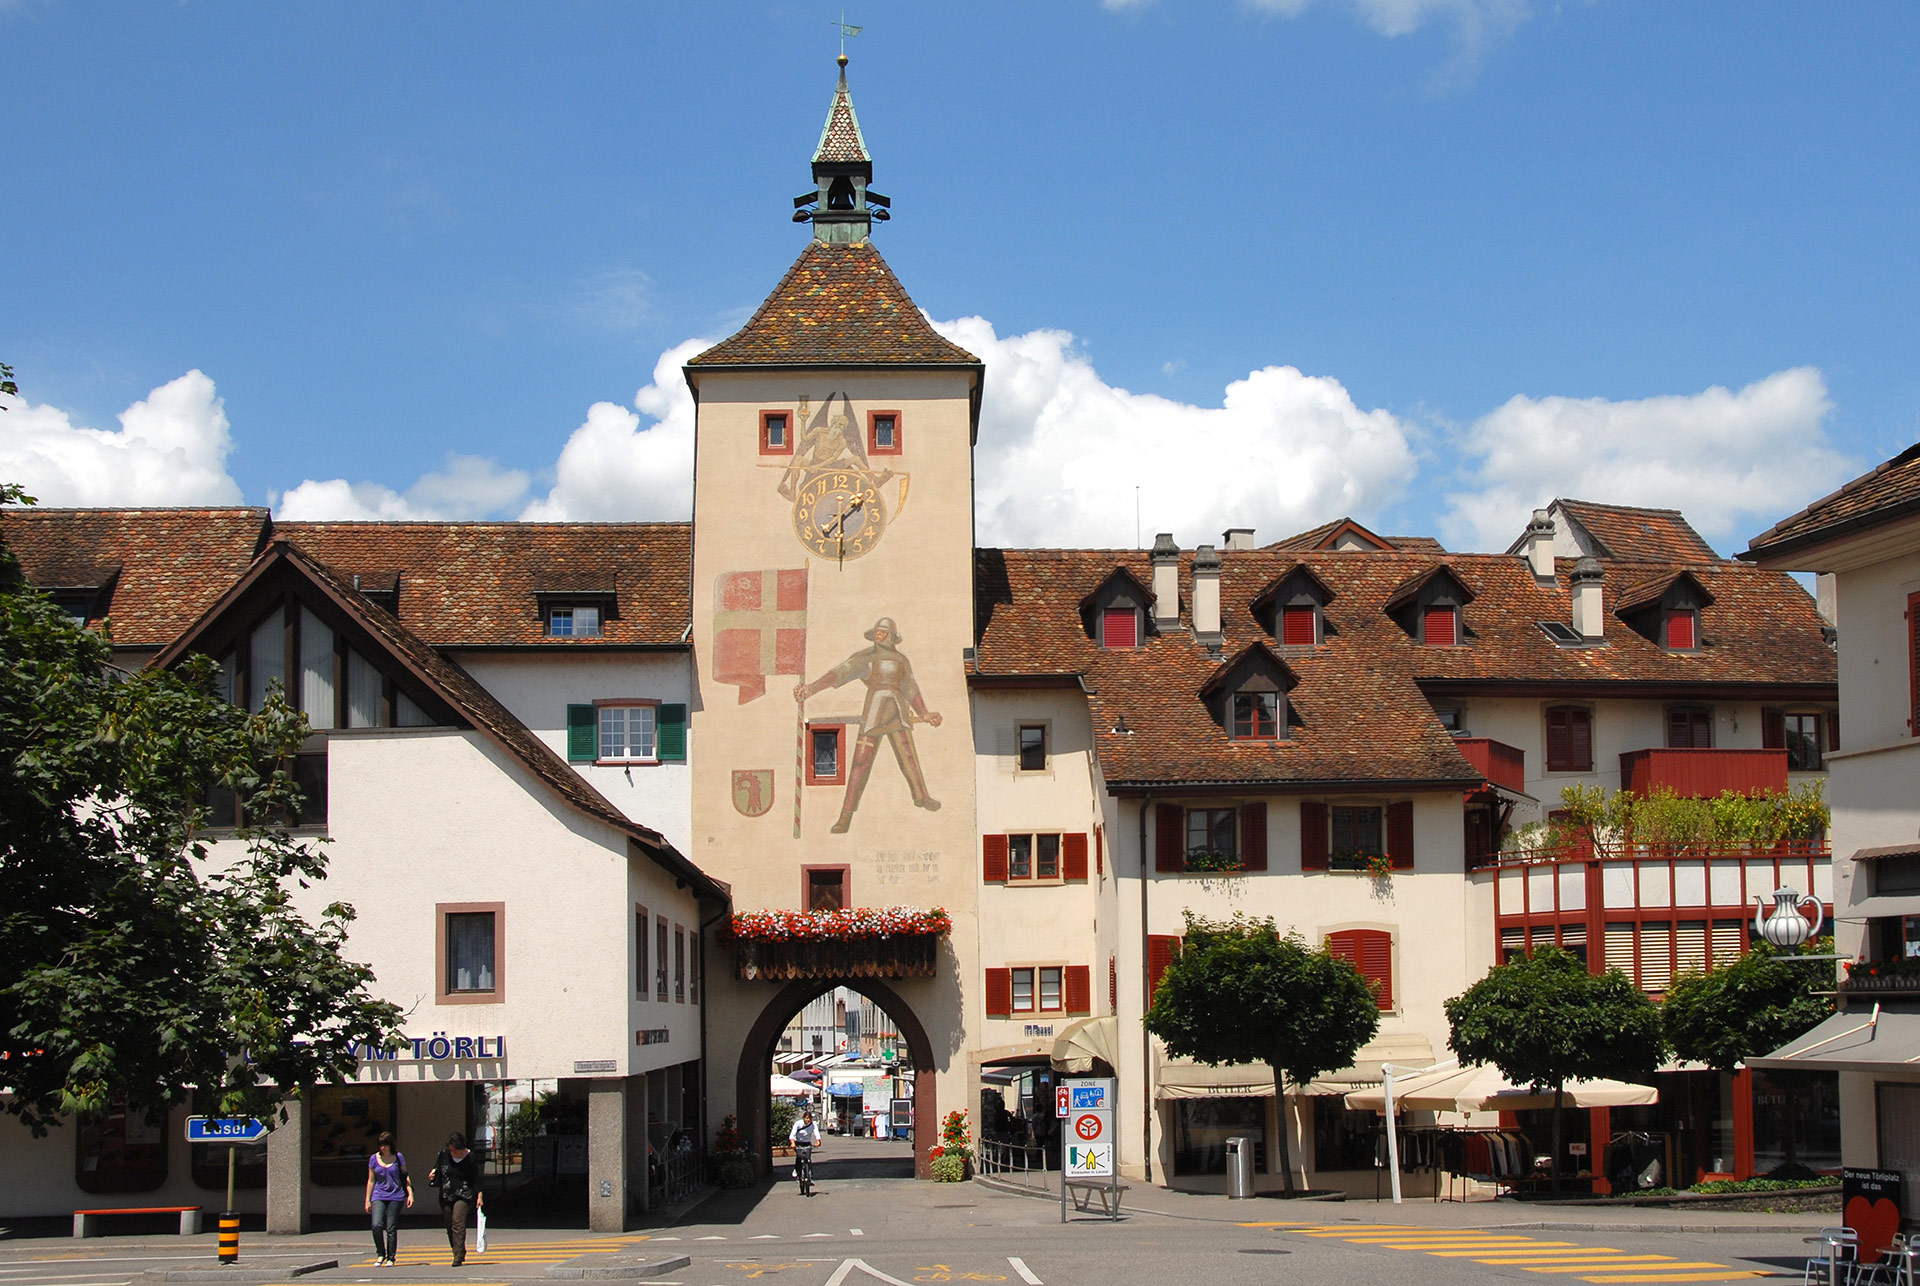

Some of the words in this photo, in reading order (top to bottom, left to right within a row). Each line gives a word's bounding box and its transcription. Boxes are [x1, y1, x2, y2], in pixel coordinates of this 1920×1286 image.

[816, 479, 826, 496] 11
[832, 475, 848, 489] 12
[801, 492, 815, 506] 10
[865, 489, 876, 504] 2
[799, 508, 808, 522] 9
[871, 508, 880, 522] 3
[804, 525, 813, 540] 8
[864, 525, 876, 540] 4
[815, 539, 826, 553] 7
[852, 538, 863, 553] 5
[410, 1031, 504, 1060] TÖRLI
[1208, 1083, 1253, 1095] BÜTLER
[1843, 1170, 1855, 1178] Der
[1855, 1172, 1871, 1180] neue
[1861, 1181, 1870, 1190] ist
[1870, 1182, 1882, 1190] das
